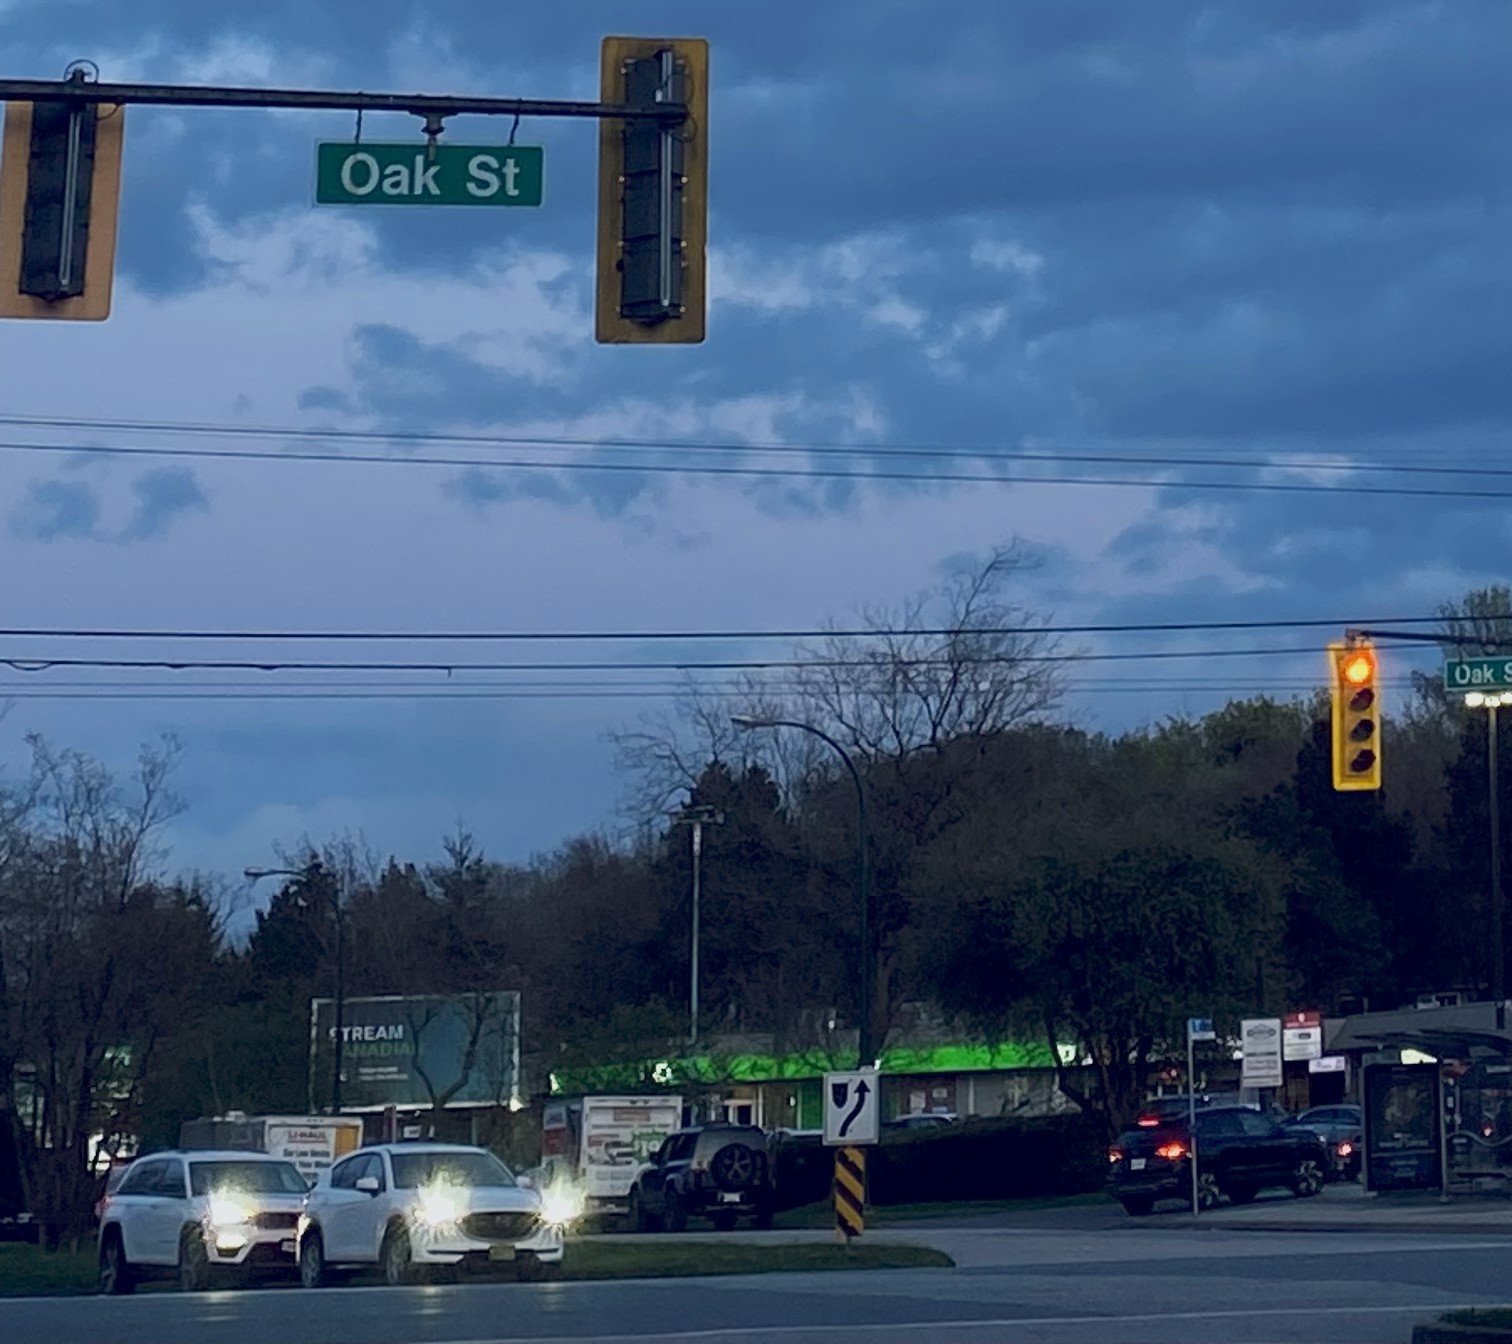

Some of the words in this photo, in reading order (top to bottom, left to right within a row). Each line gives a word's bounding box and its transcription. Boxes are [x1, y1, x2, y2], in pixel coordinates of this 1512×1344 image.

[341, 152, 441, 196] Oak
[466, 154, 520, 198] St
[1454, 663, 1495, 685] Oak
